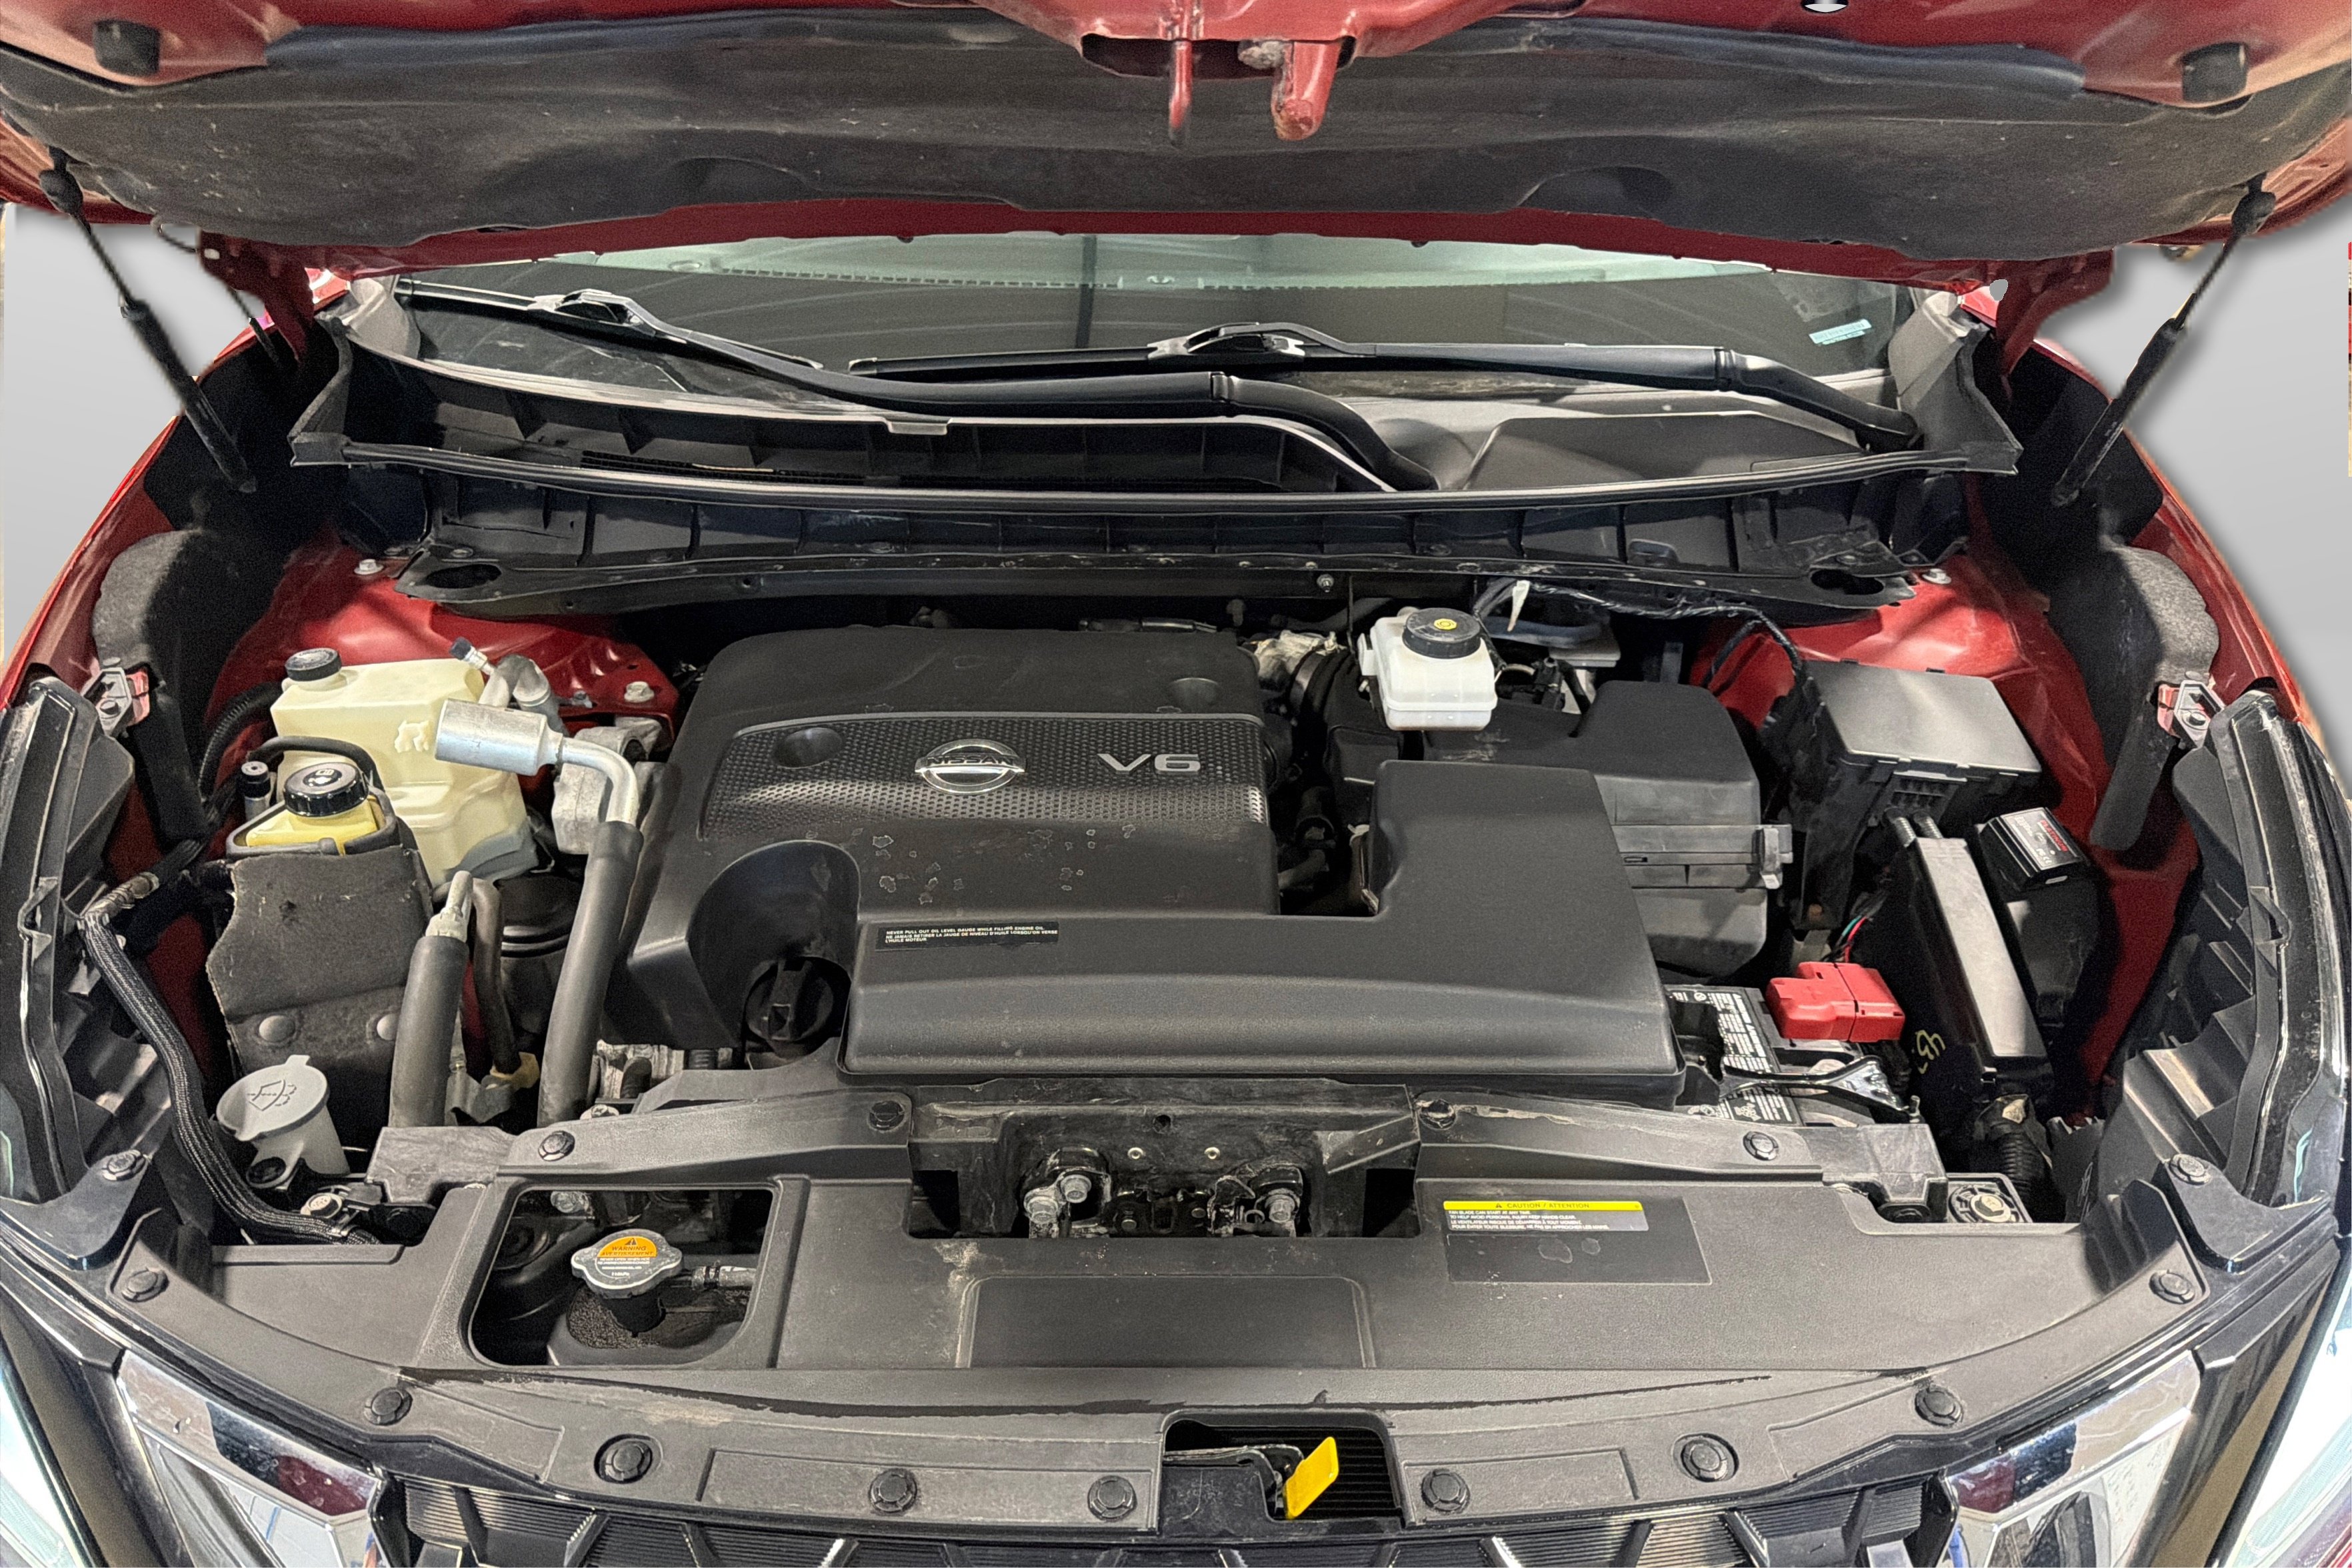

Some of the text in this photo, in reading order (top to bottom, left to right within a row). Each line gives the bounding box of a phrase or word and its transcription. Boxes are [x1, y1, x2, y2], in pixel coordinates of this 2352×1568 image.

[927, 754, 1013, 766] NISSAN
[1097, 753, 1201, 773] V6
[2040, 819, 2069, 852] PLATINUM
